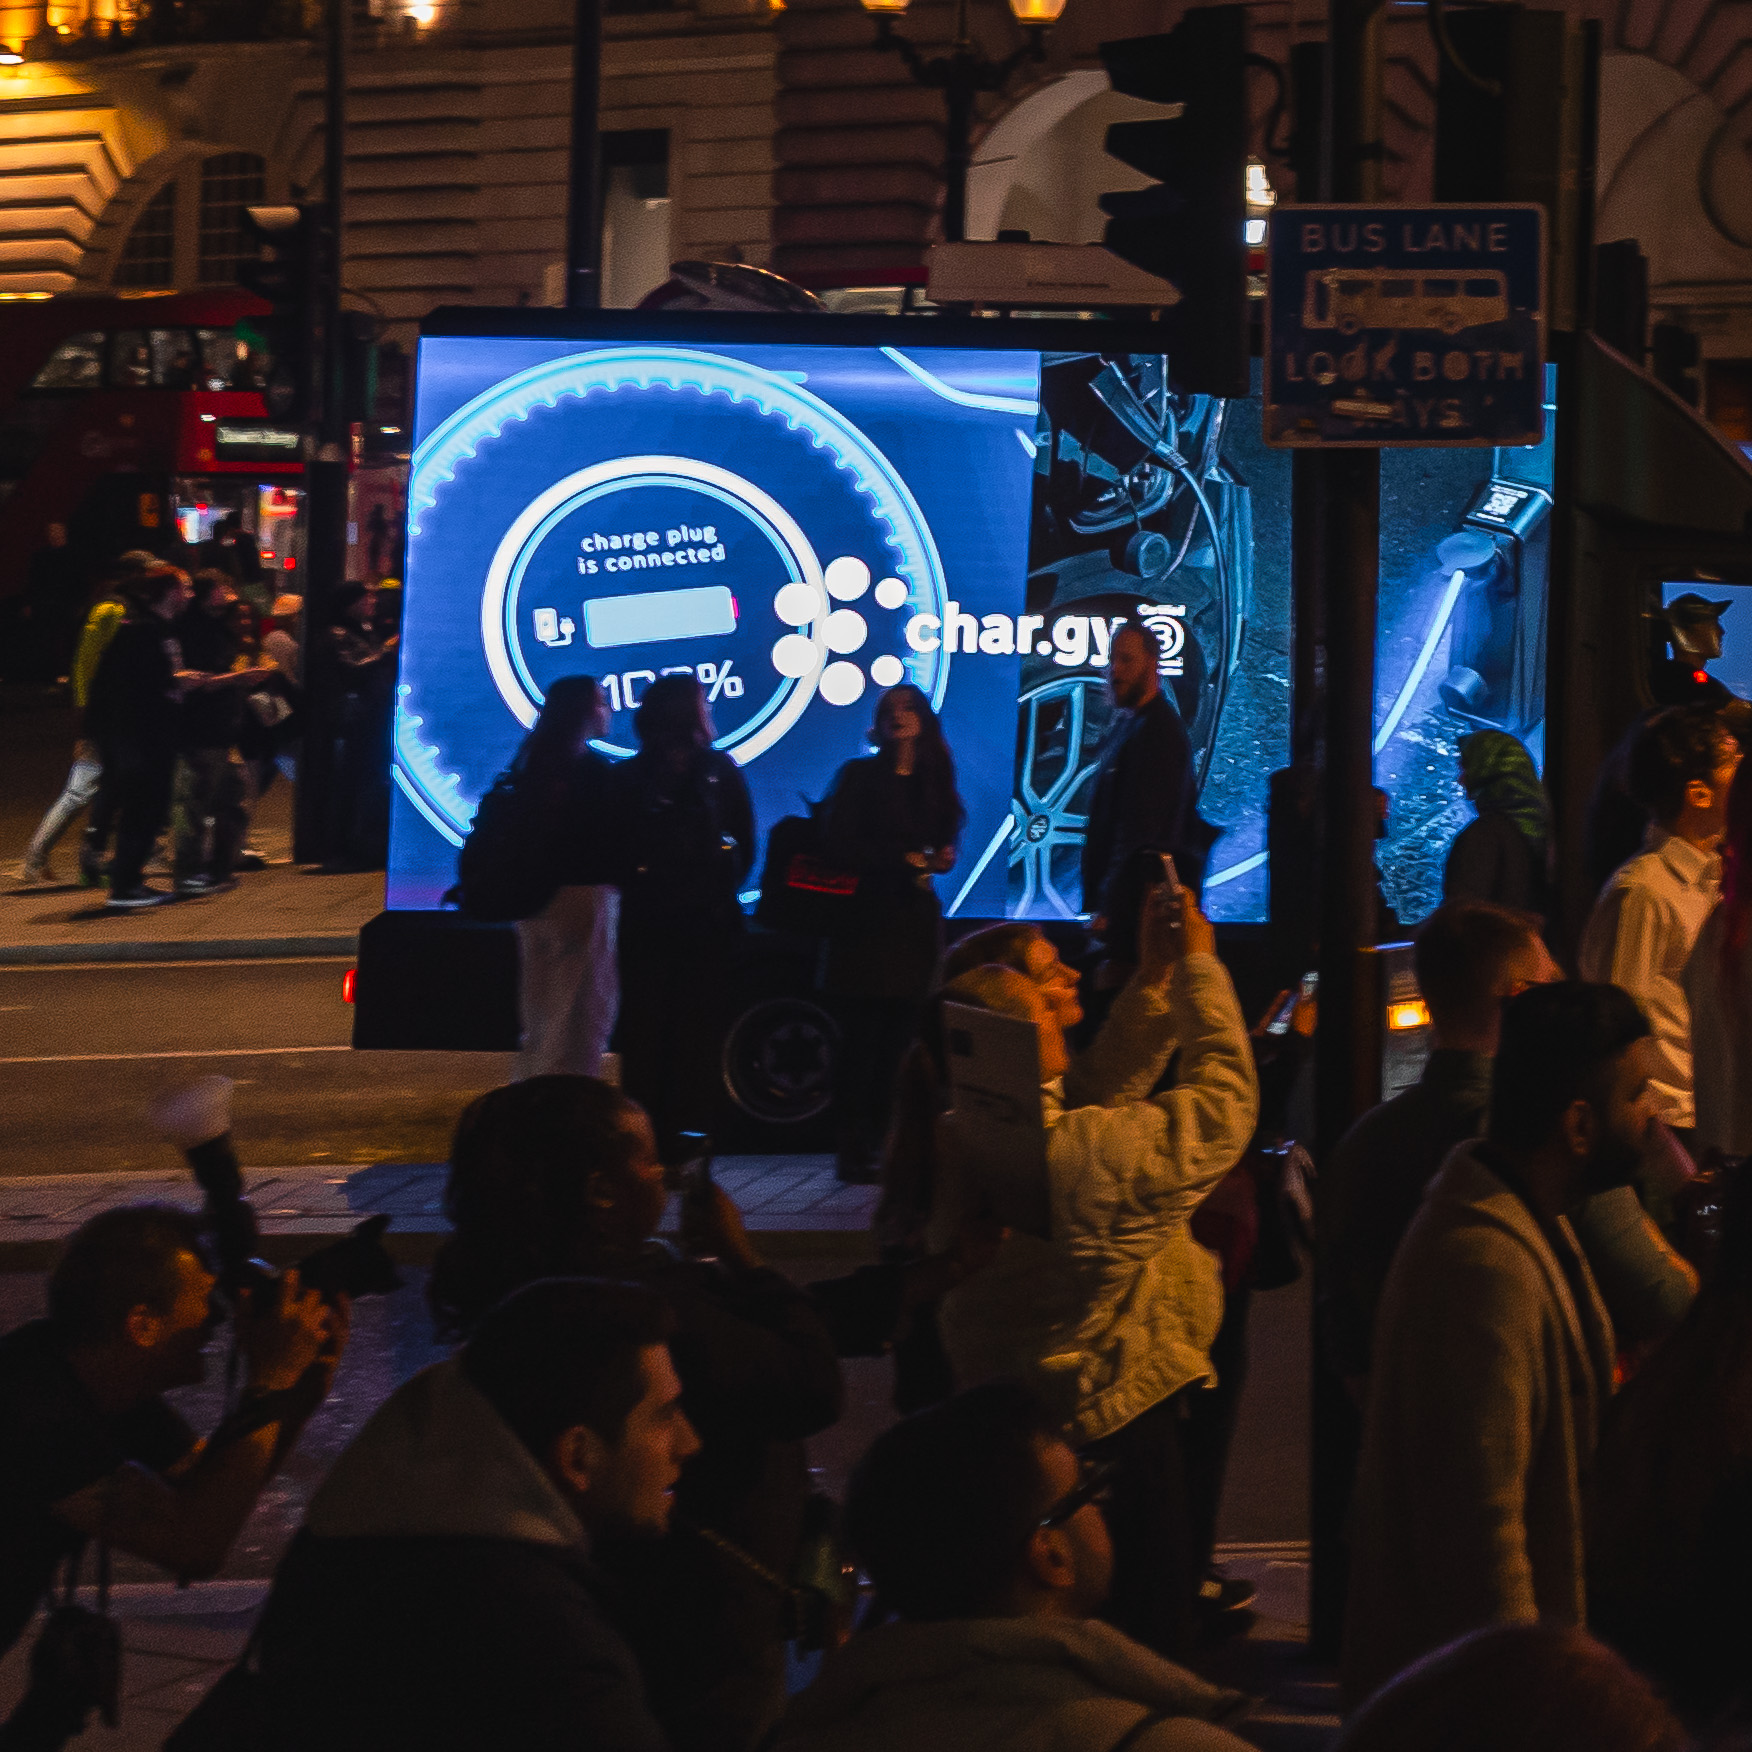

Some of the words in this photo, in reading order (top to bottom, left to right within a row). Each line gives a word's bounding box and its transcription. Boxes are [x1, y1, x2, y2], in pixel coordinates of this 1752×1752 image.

[1300, 223, 1388, 253] BUS
[1402, 222, 1510, 253] LANE
[1285, 350, 1399, 384] LOOK
[1411, 351, 1526, 382] BOTH
[1353, 397, 1470, 429] AYS
[581, 532, 660, 553] charge
[666, 524, 718, 547] plug
[577, 556, 600, 575] is
[604, 543, 726, 573] connected
[905, 600, 1129, 667] char.gy
